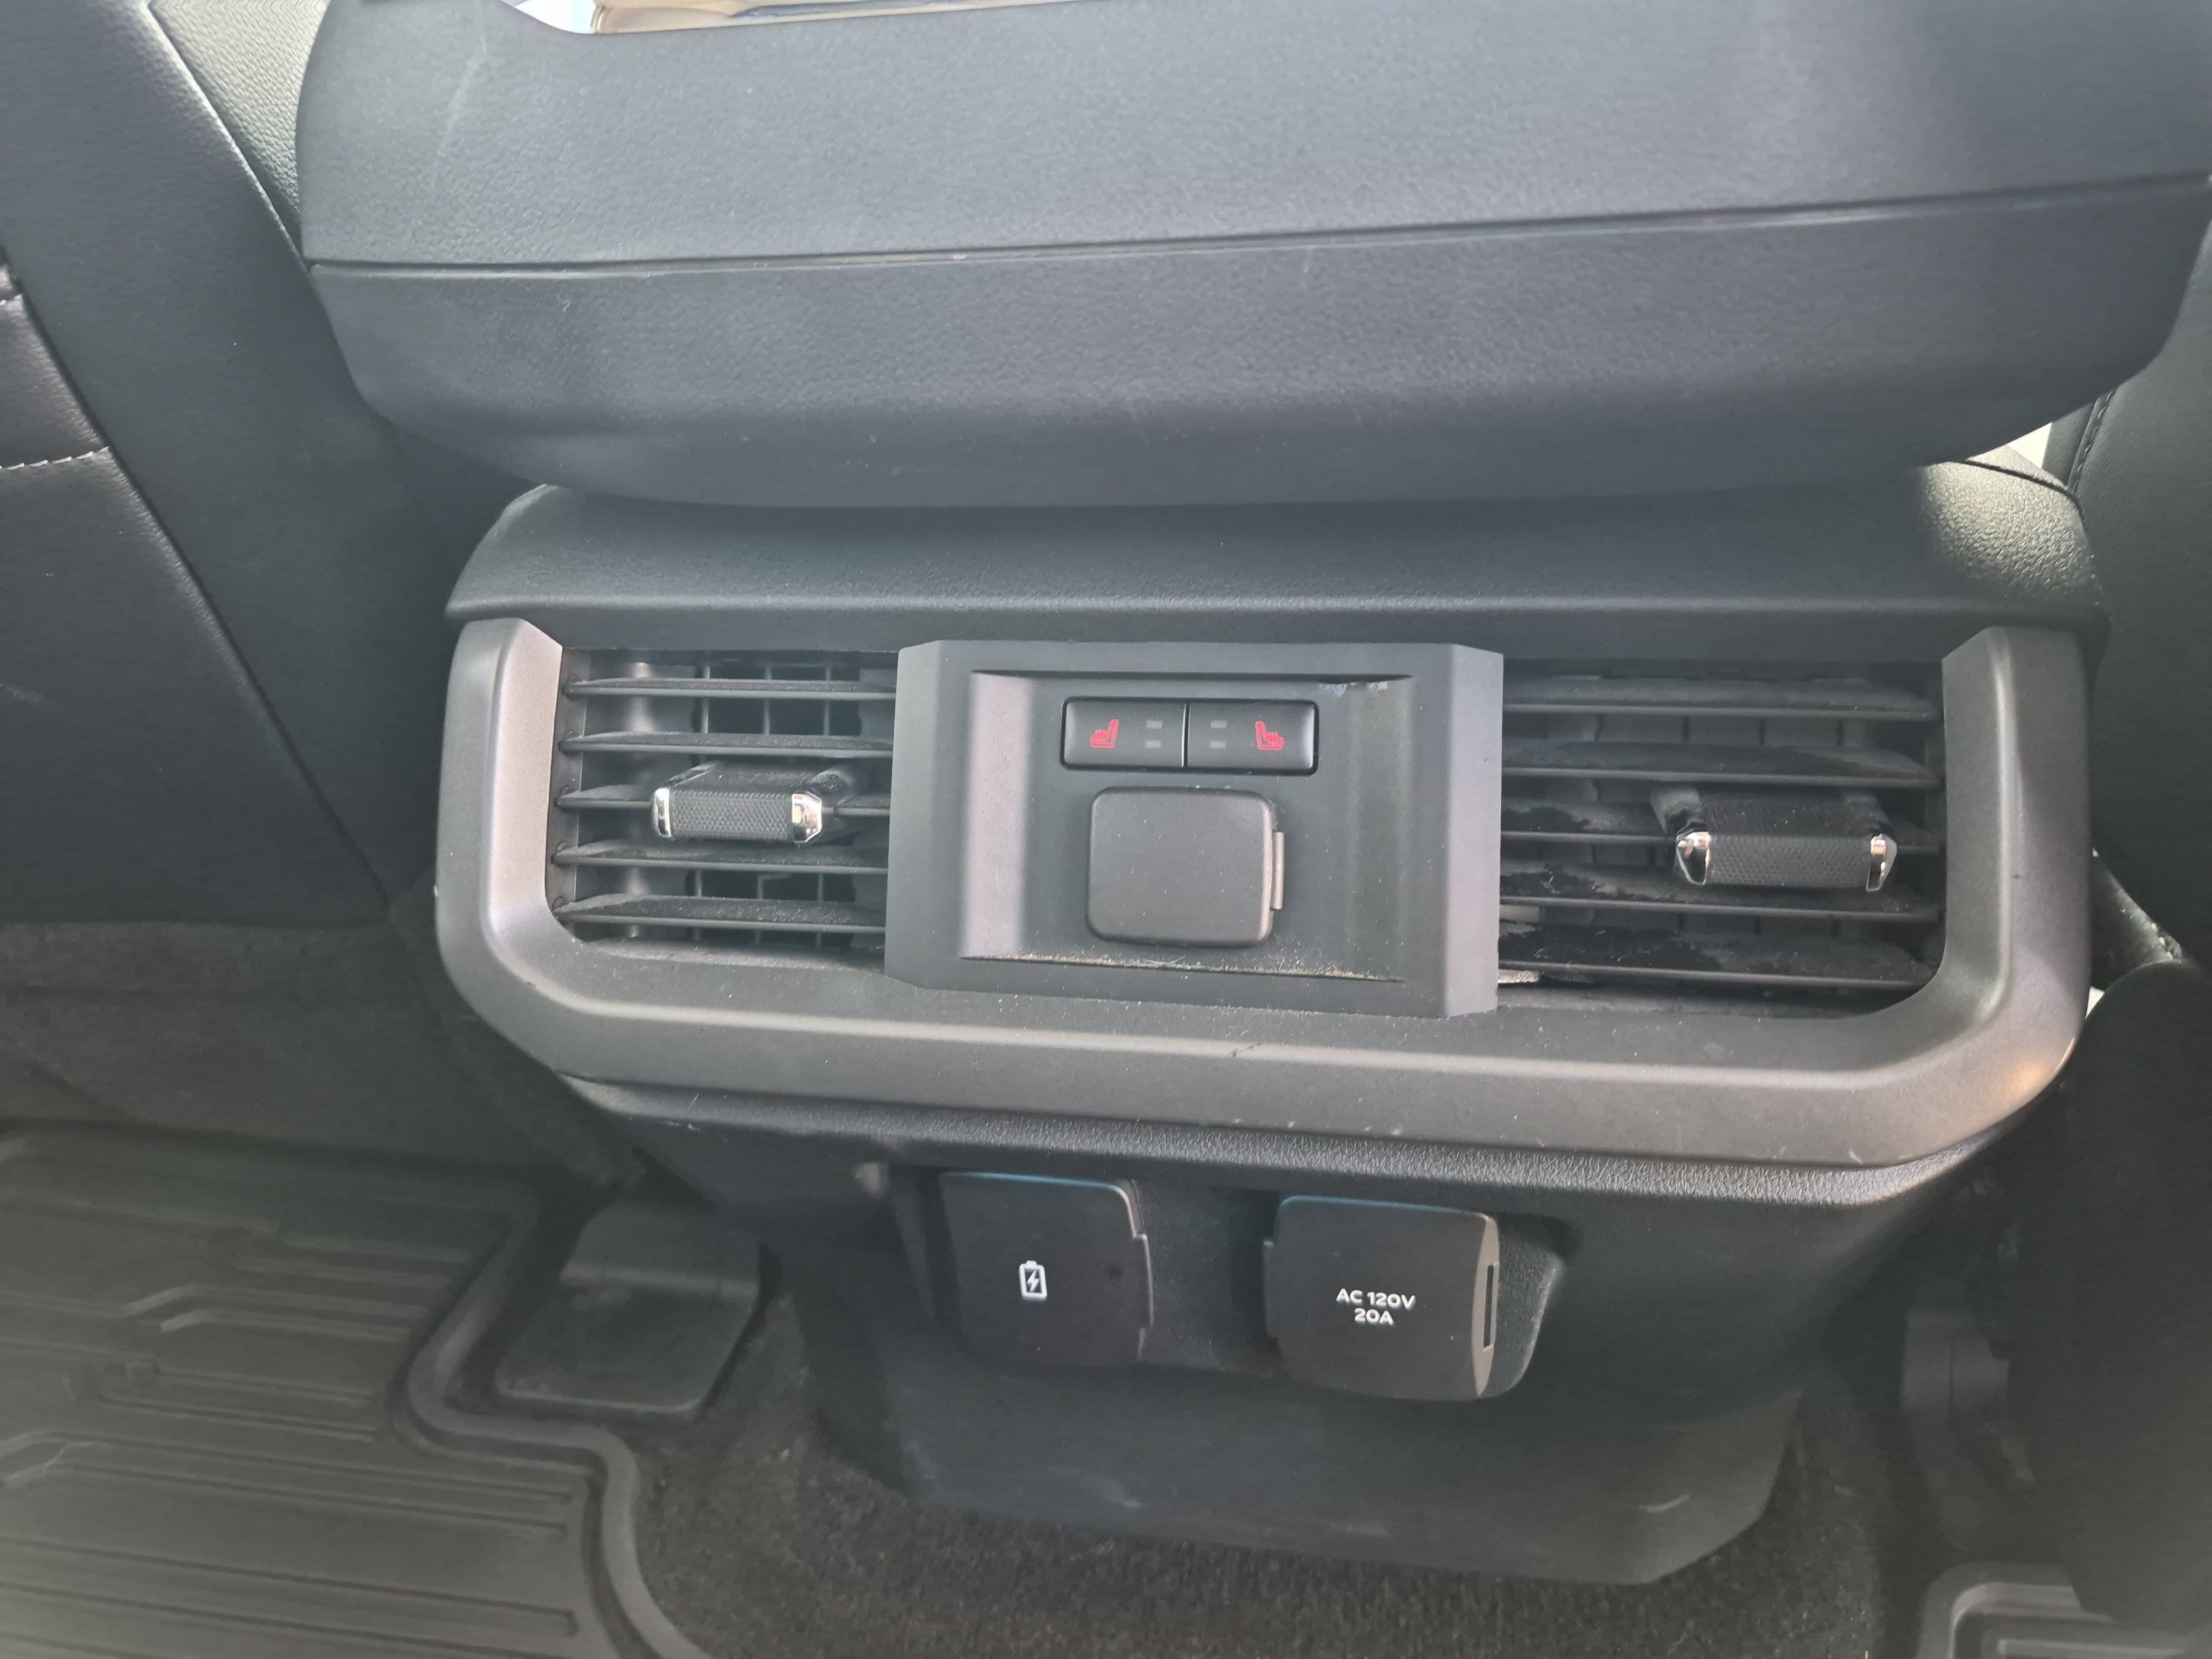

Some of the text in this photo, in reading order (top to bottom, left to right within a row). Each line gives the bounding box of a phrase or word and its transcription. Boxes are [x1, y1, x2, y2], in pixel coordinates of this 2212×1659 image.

[1336, 1288, 1416, 1309] AC 120V
[1354, 1308, 1394, 1325] 20A
